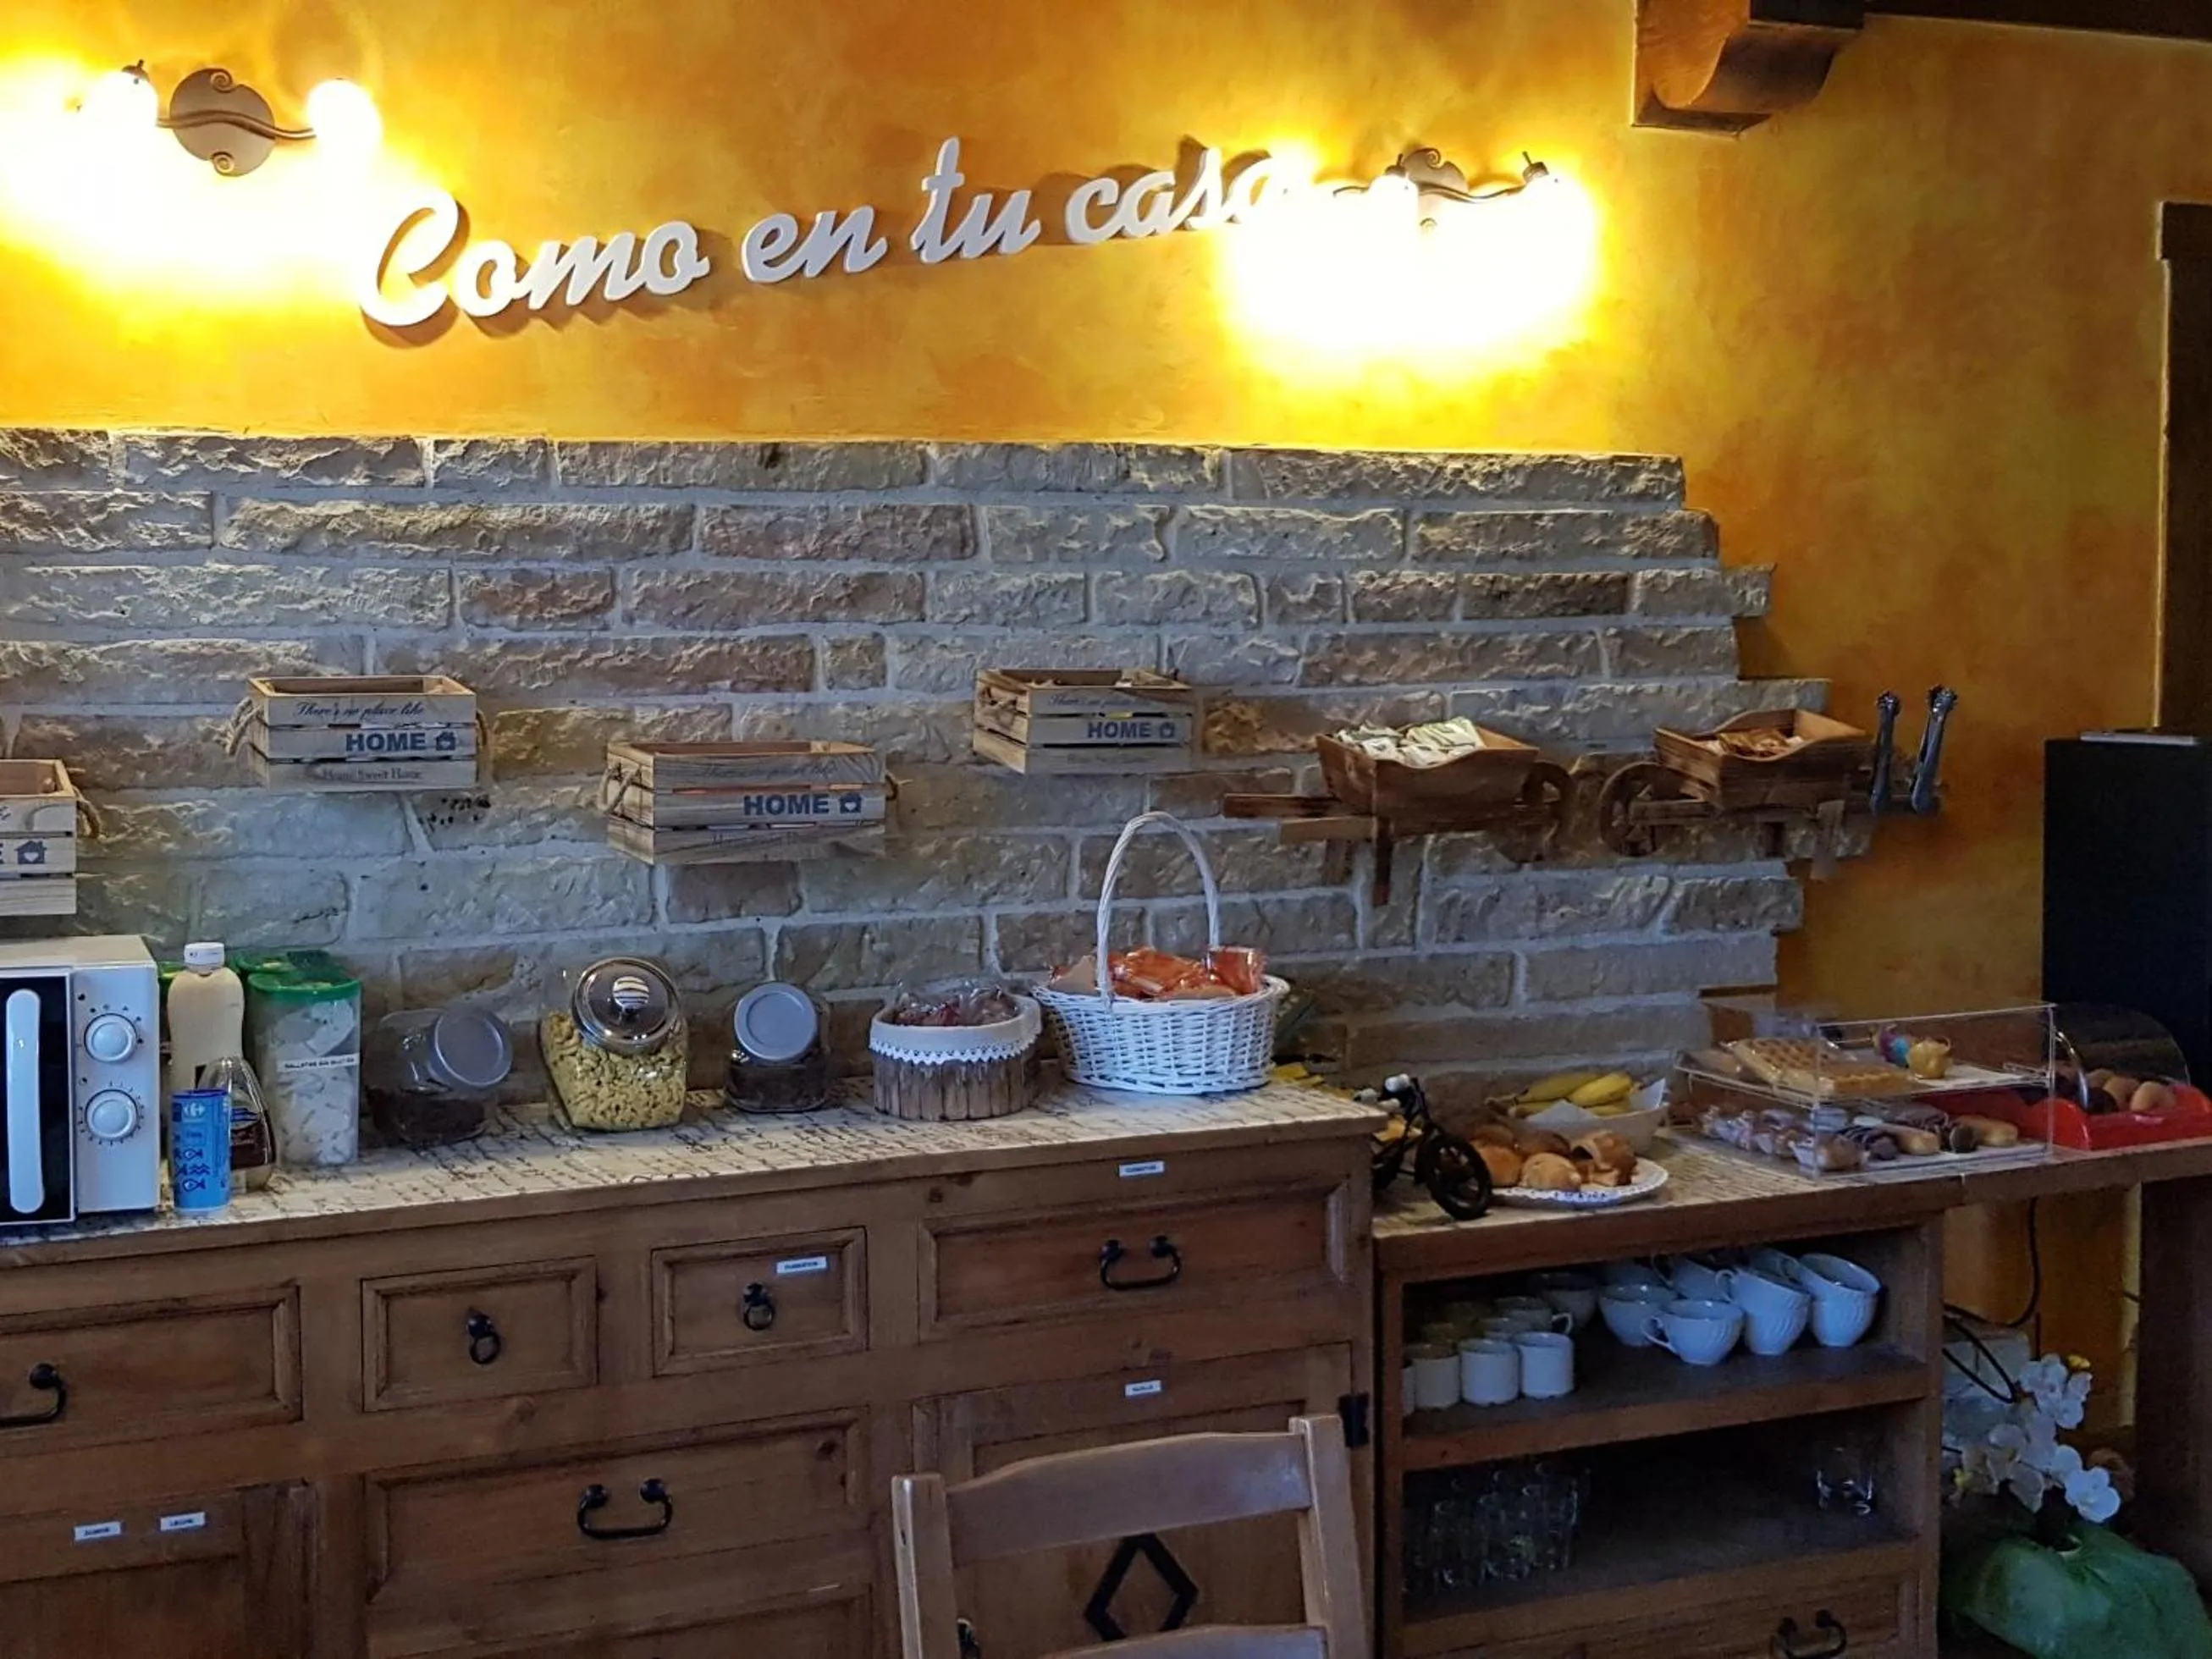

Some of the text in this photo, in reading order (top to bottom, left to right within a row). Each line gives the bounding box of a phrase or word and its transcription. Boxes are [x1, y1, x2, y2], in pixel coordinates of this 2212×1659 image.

[359, 135, 1288, 326] Como en tu casa
[1087, 721, 1152, 739] HOME
[345, 732, 426, 752] HOME
[743, 794, 830, 816] HOME
